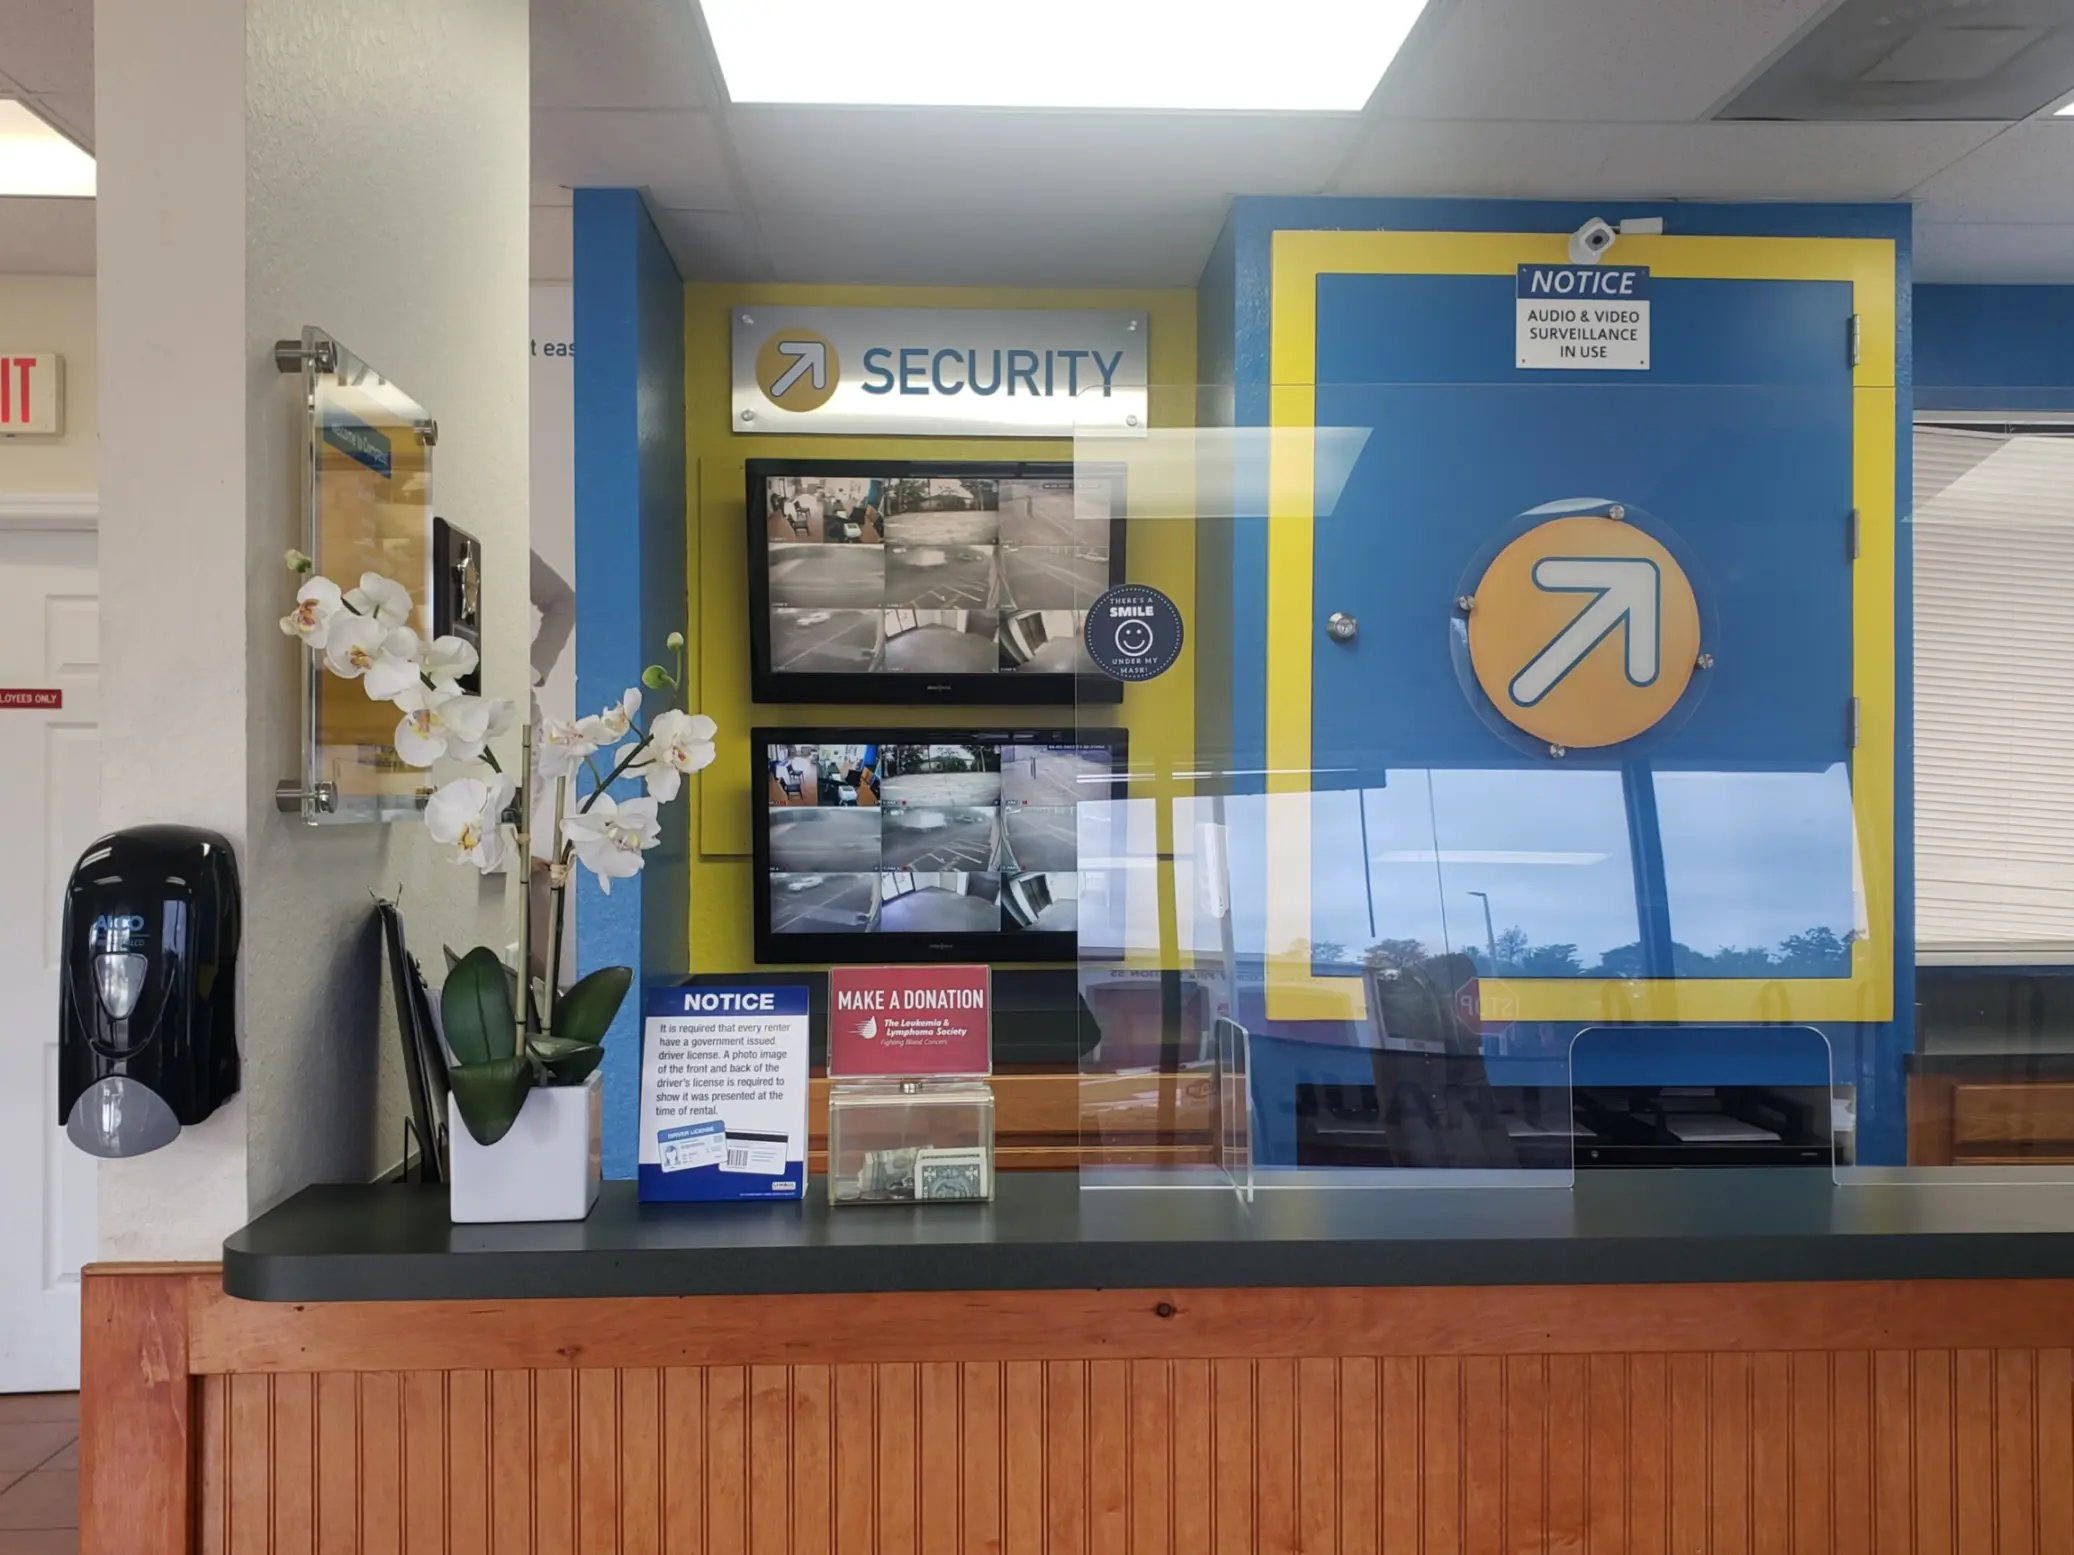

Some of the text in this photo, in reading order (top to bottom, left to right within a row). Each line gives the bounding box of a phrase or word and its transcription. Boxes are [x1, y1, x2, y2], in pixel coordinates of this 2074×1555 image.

[1531, 270, 1636, 294] NOTICE
[1528, 310, 1640, 323] AUDIO & VIDEO
[1530, 327, 1638, 341] SURVEILLANCE
[1560, 346, 1607, 358] IN USE
[861, 347, 1124, 398] SECURITY
[1, 357, 37, 423] IT
[1109, 597, 1145, 605] THERE'S
[1109, 606, 1154, 617] SMILE
[35, 694, 57, 704] ONLY
[684, 993, 775, 1011] NOTICE
[838, 989, 984, 1010] MAKE A DONATION
[884, 1019, 950, 1027] The Leukemia &
[660, 1024, 791, 1034] It is required that every renter
[886, 1028, 967, 1037] Lymphoma Society
[659, 1037, 681, 1046] have
[692, 1037, 744, 1048] government
[747, 1036, 776, 1045] issued
[658, 1050, 787, 1061] driver license. A photo image
[658, 1063, 780, 1074] of the front and back of the
[657, 1077, 785, 1088] driver's license is required to
[656, 1091, 784, 1102] show it was presented at the
[655, 1106, 718, 1116] time of rental.
